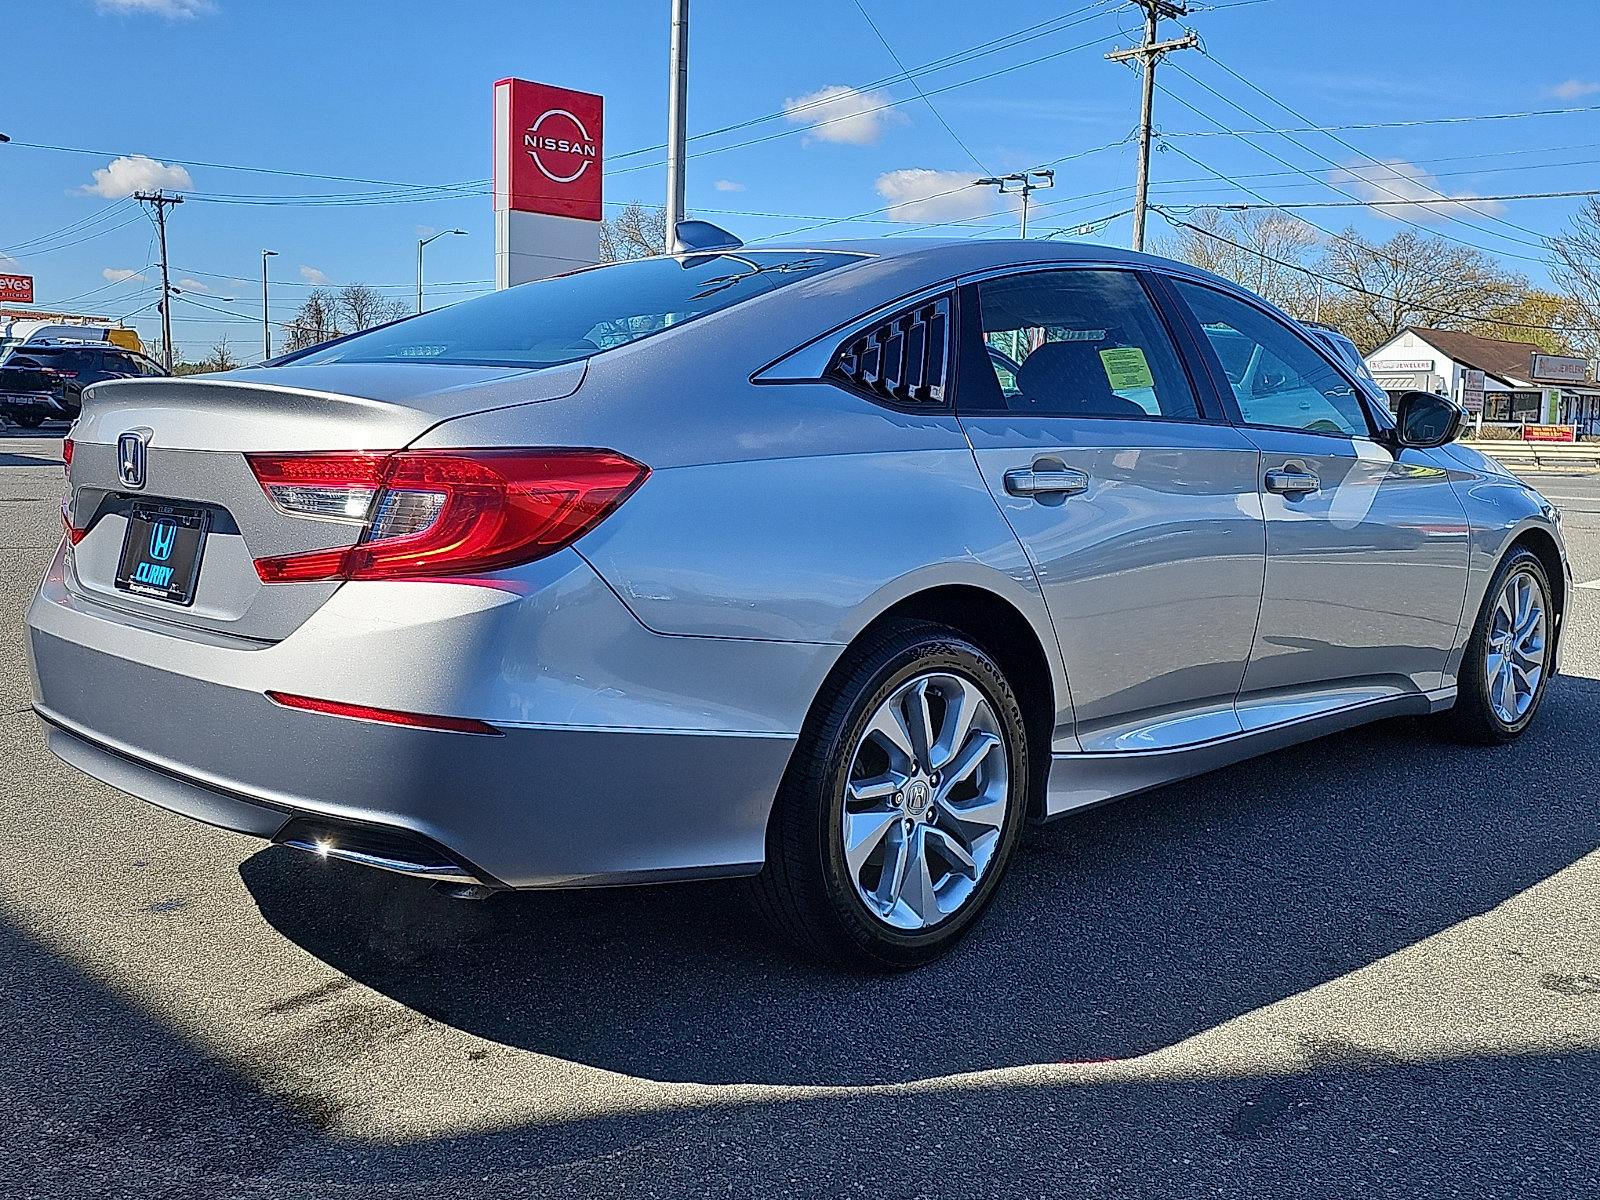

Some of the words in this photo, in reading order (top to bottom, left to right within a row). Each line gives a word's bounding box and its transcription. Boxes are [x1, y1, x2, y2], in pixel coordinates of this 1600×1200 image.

[524, 134, 596, 157] NISSAN
[135, 562, 175, 587] CURRY
[976, 655, 1013, 699] FORAY
